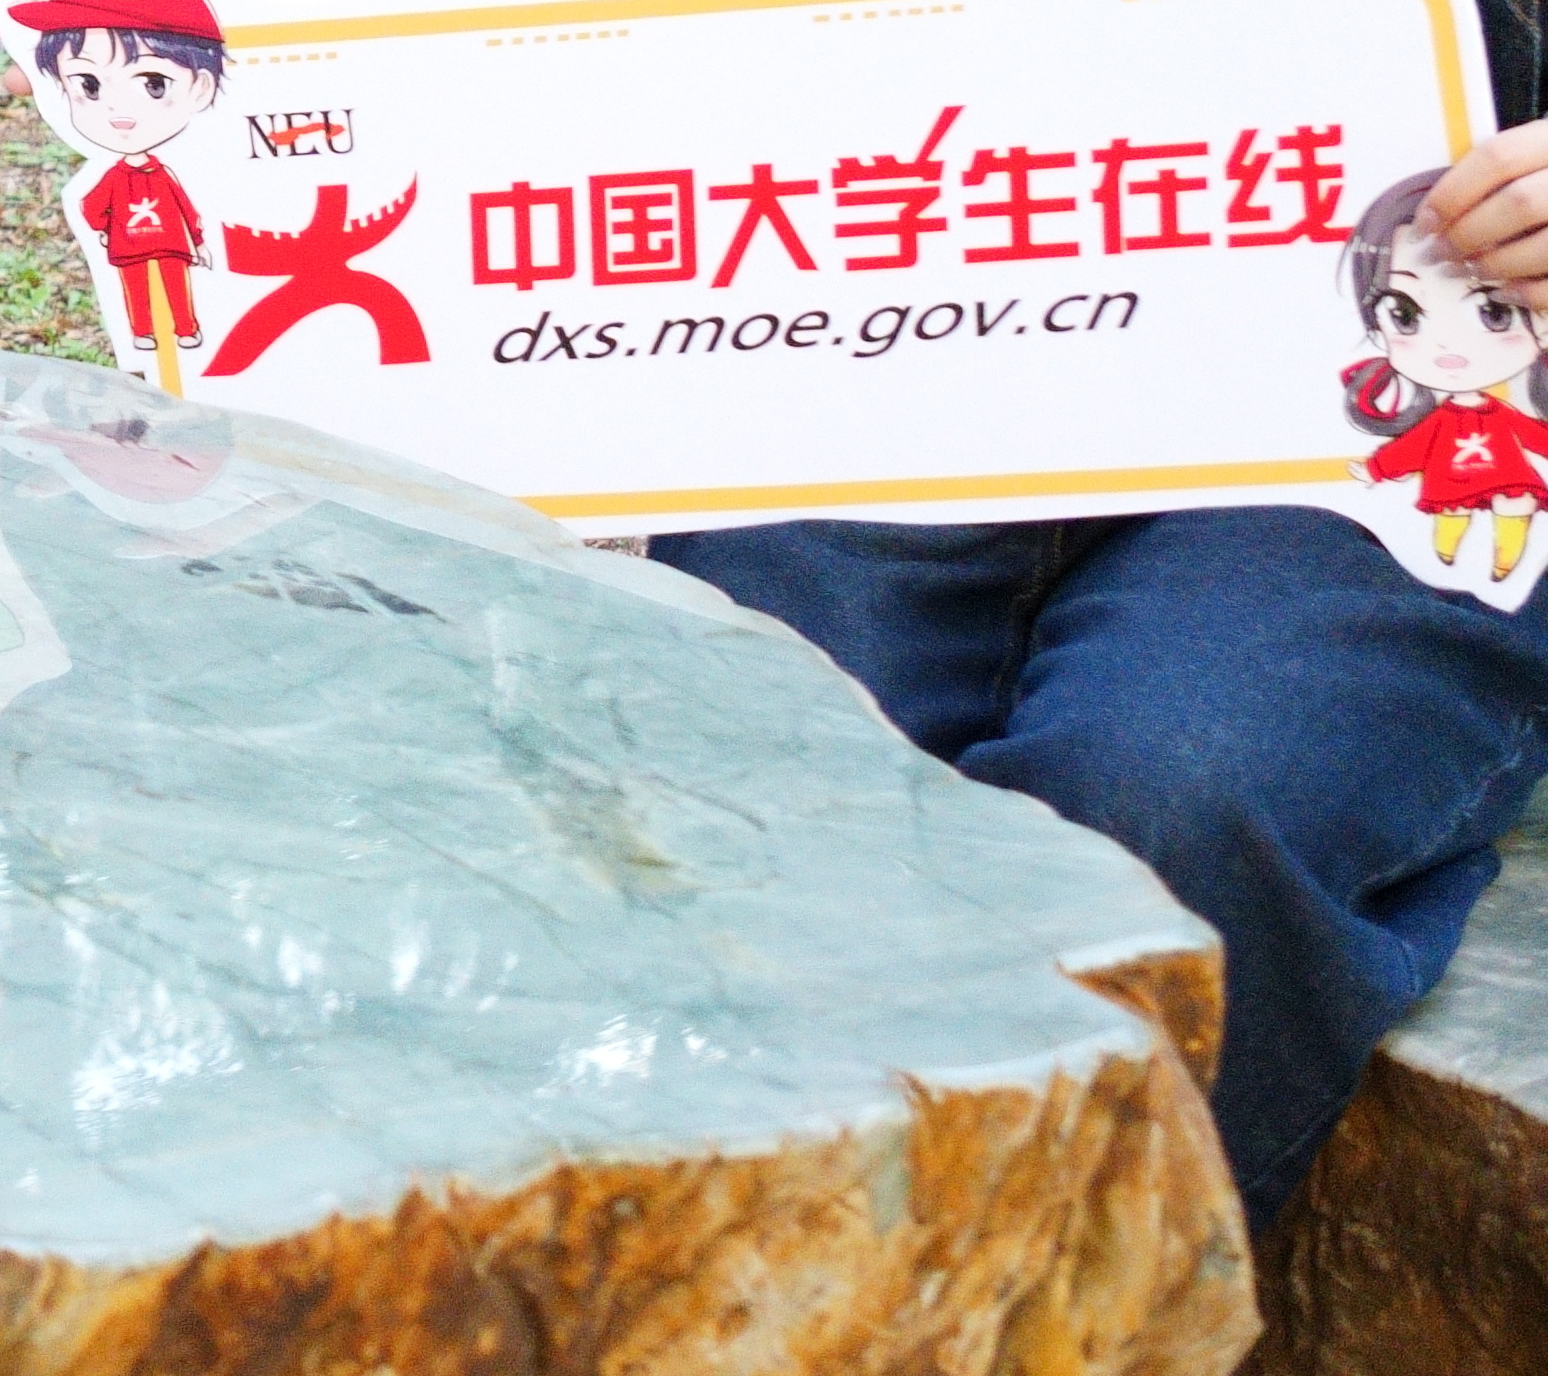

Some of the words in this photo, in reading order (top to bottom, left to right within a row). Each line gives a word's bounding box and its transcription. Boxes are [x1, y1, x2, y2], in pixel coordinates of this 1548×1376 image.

[244, 108, 355, 160] NEU
[470, 104, 1353, 293] 中国大学生在线
[493, 288, 1139, 366] dxs.moe.gov.cn
